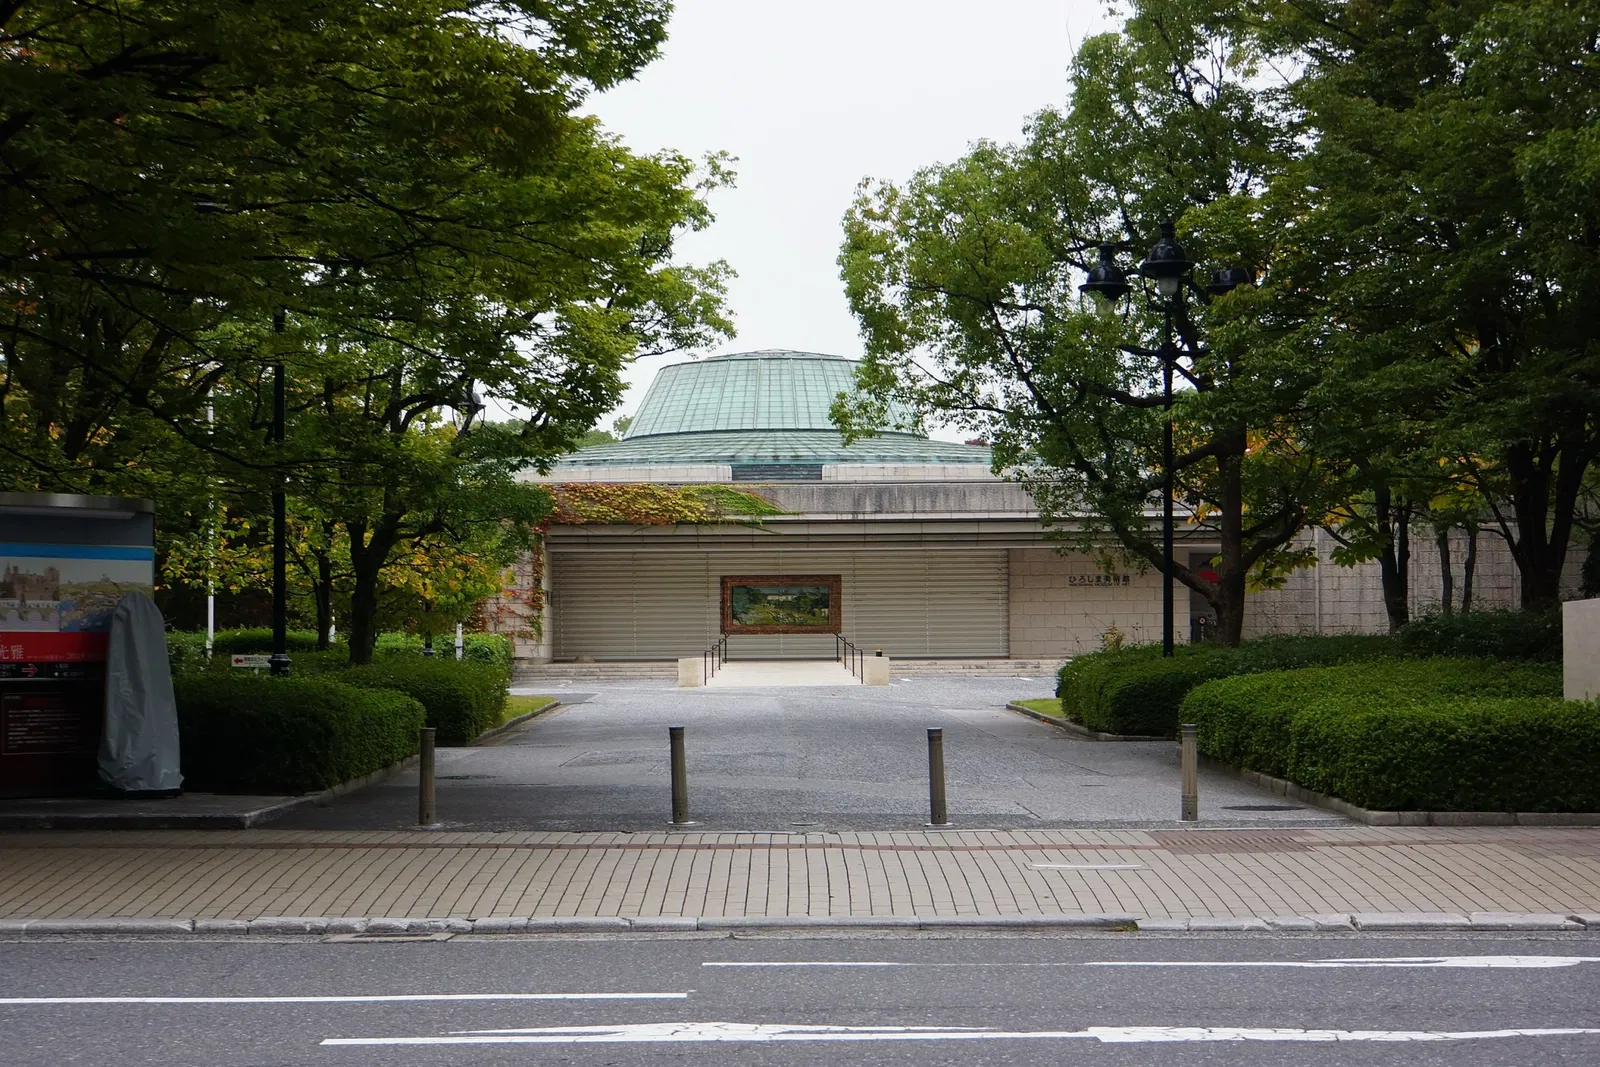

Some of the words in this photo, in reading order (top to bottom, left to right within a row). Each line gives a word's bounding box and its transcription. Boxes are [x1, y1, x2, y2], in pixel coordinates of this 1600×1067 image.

[1068, 575, 1130, 583] ひろしま美術館
